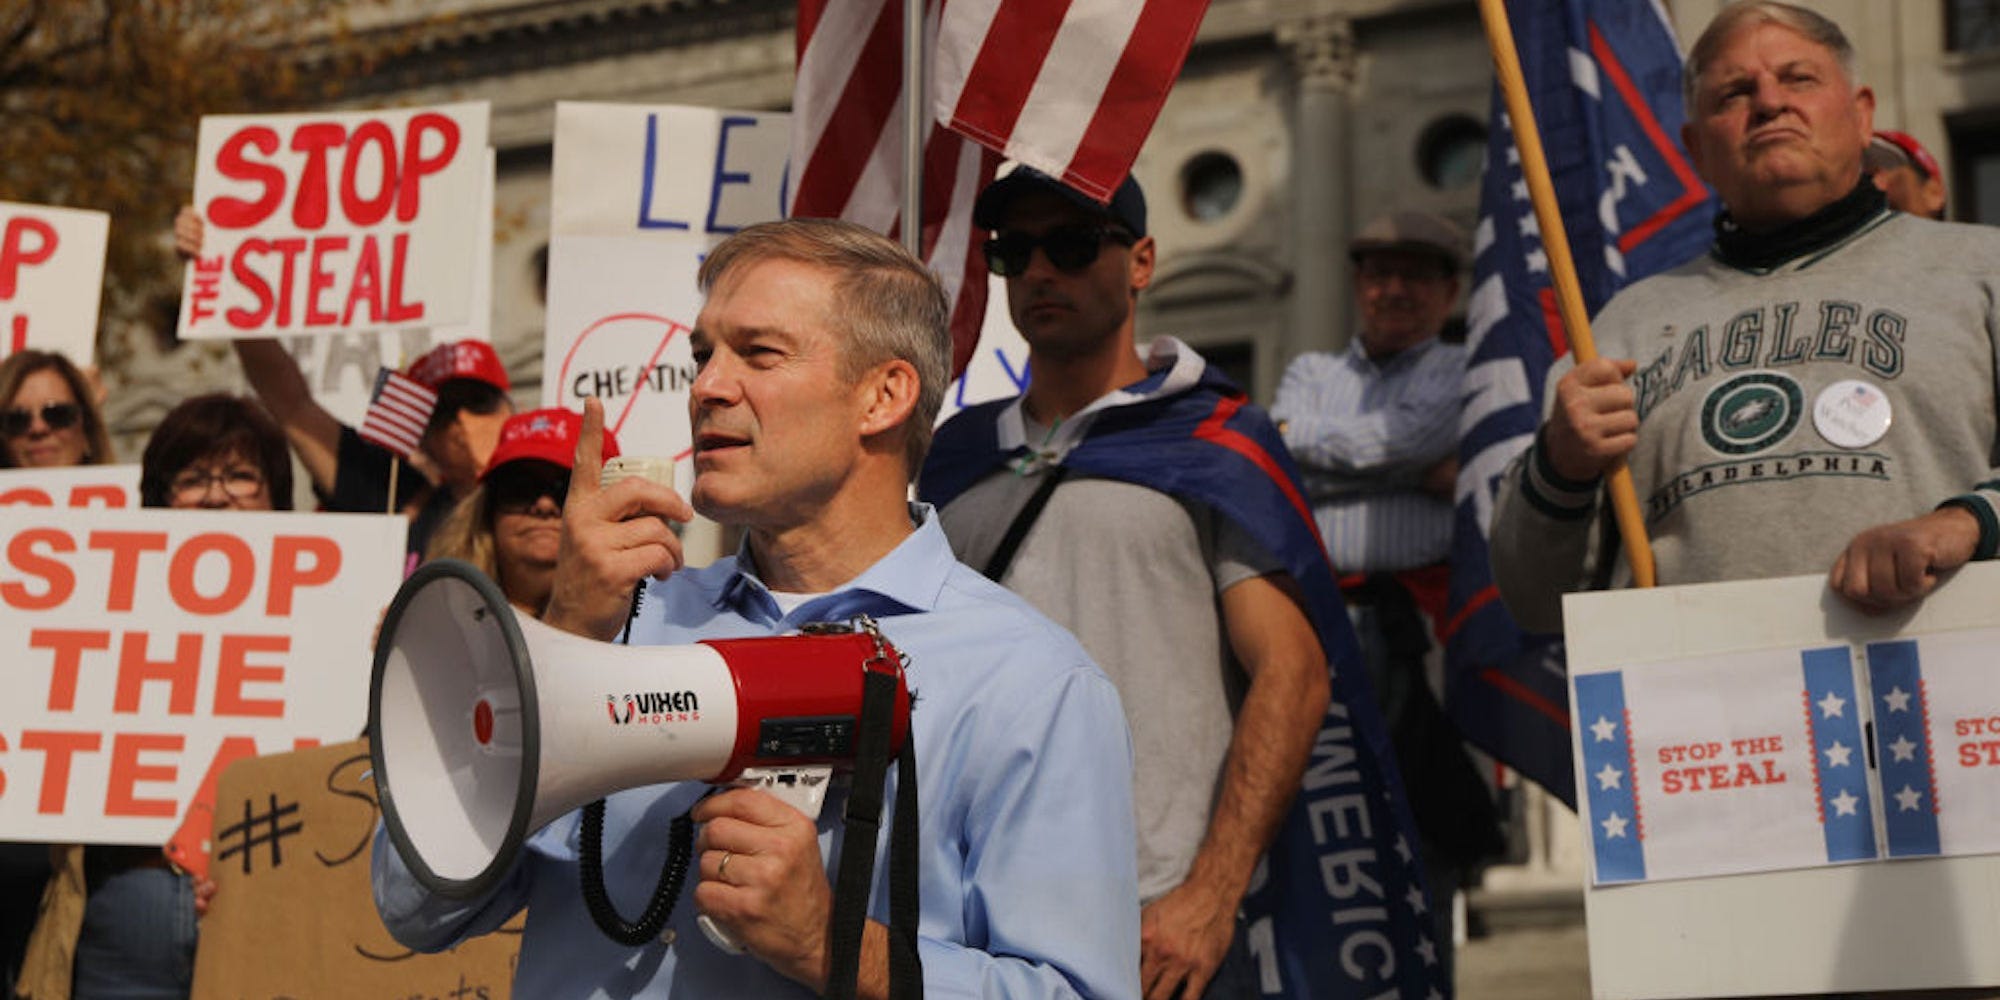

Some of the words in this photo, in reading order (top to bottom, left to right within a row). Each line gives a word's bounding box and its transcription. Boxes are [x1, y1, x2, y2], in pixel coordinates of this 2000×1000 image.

[207, 112, 461, 229] STOP
[637, 113, 790, 234] LE
[190, 254, 224, 327] THE
[226, 233, 425, 329] STEAL
[1634, 300, 1908, 420] EAGLES
[0, 528, 342, 617] STOP
[29, 629, 292, 719] THE
[635, 690, 698, 713] VIXEN
[638, 711, 700, 724] HORNS
[1658, 743, 1723, 765] STOP
[1731, 735, 1784, 757] THE
[1661, 759, 1787, 795] STEAL
